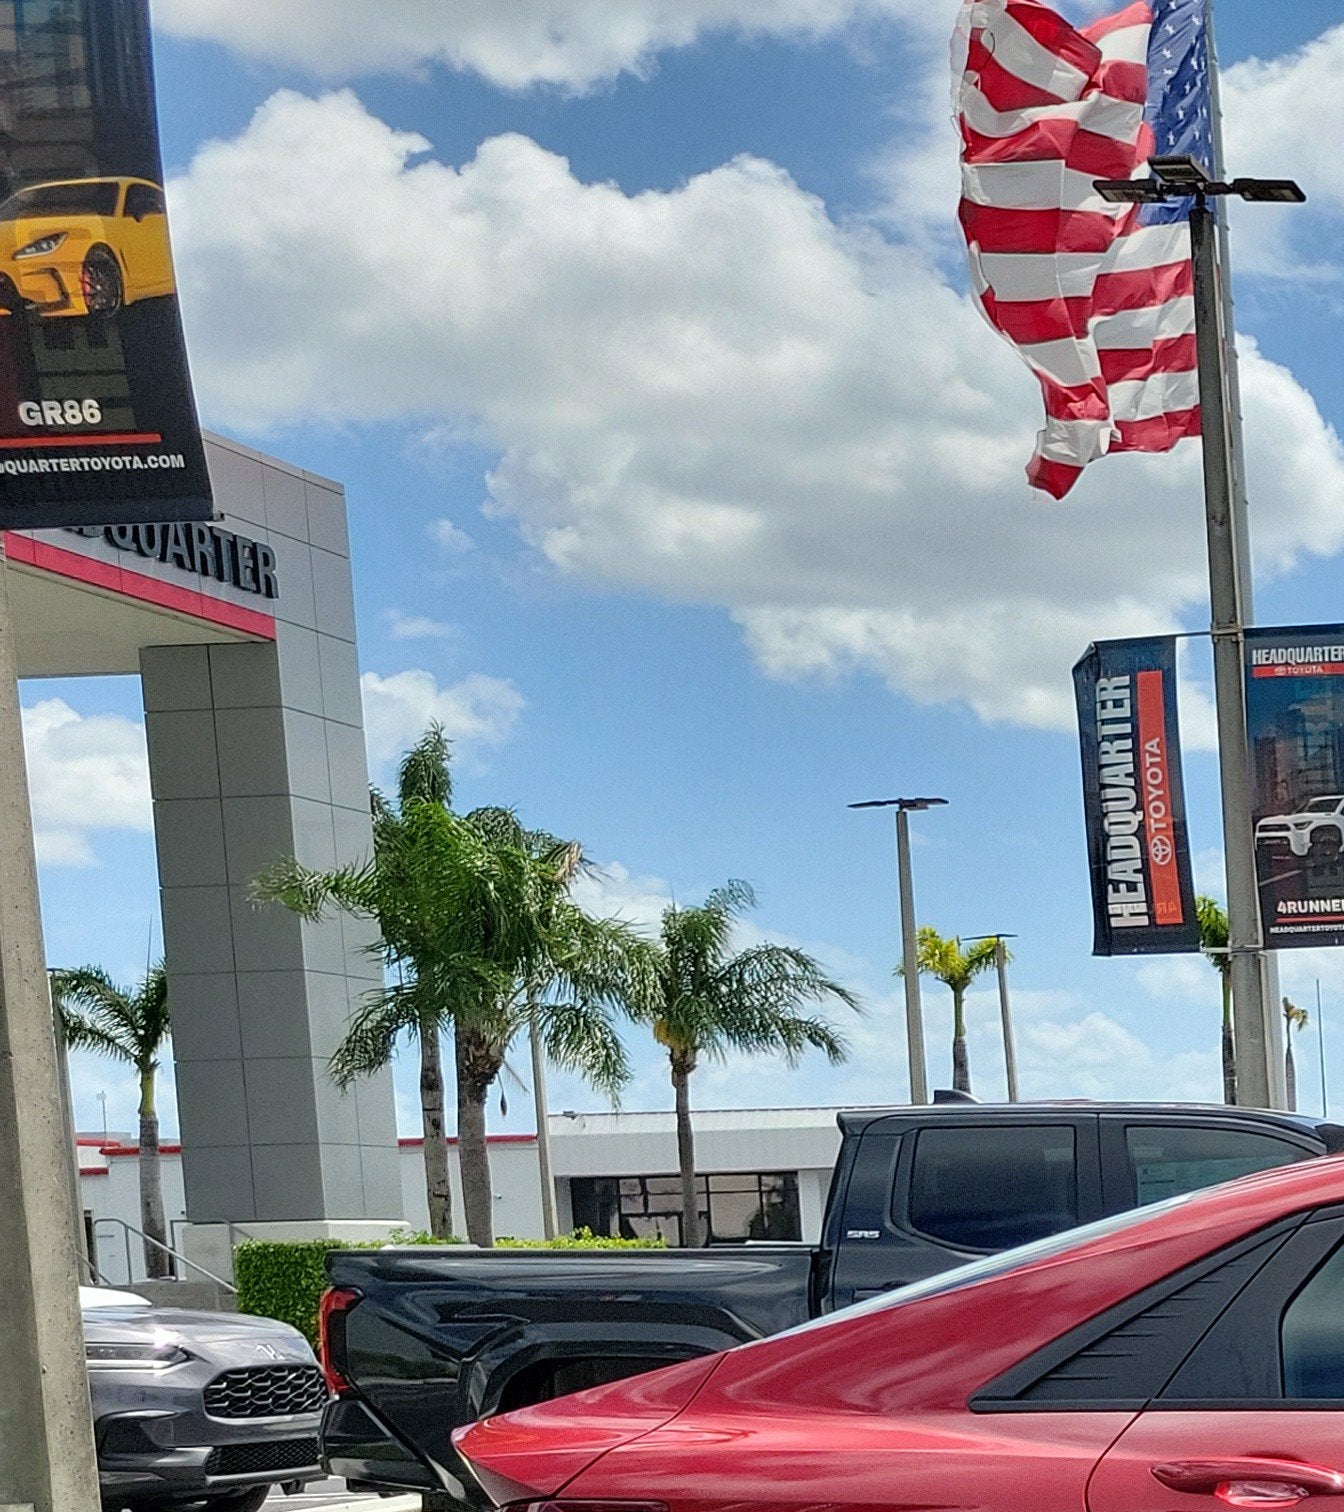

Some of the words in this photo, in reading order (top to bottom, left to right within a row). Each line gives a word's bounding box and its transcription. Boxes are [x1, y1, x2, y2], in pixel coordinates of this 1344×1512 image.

[18, 399, 102, 426] GR86
[65, 522, 279, 598] QUARTER
[1287, 664, 1323, 675] TOYOTA
[1095, 674, 1150, 929] HEADQUARTER
[1145, 737, 1168, 832] TOYOTA
